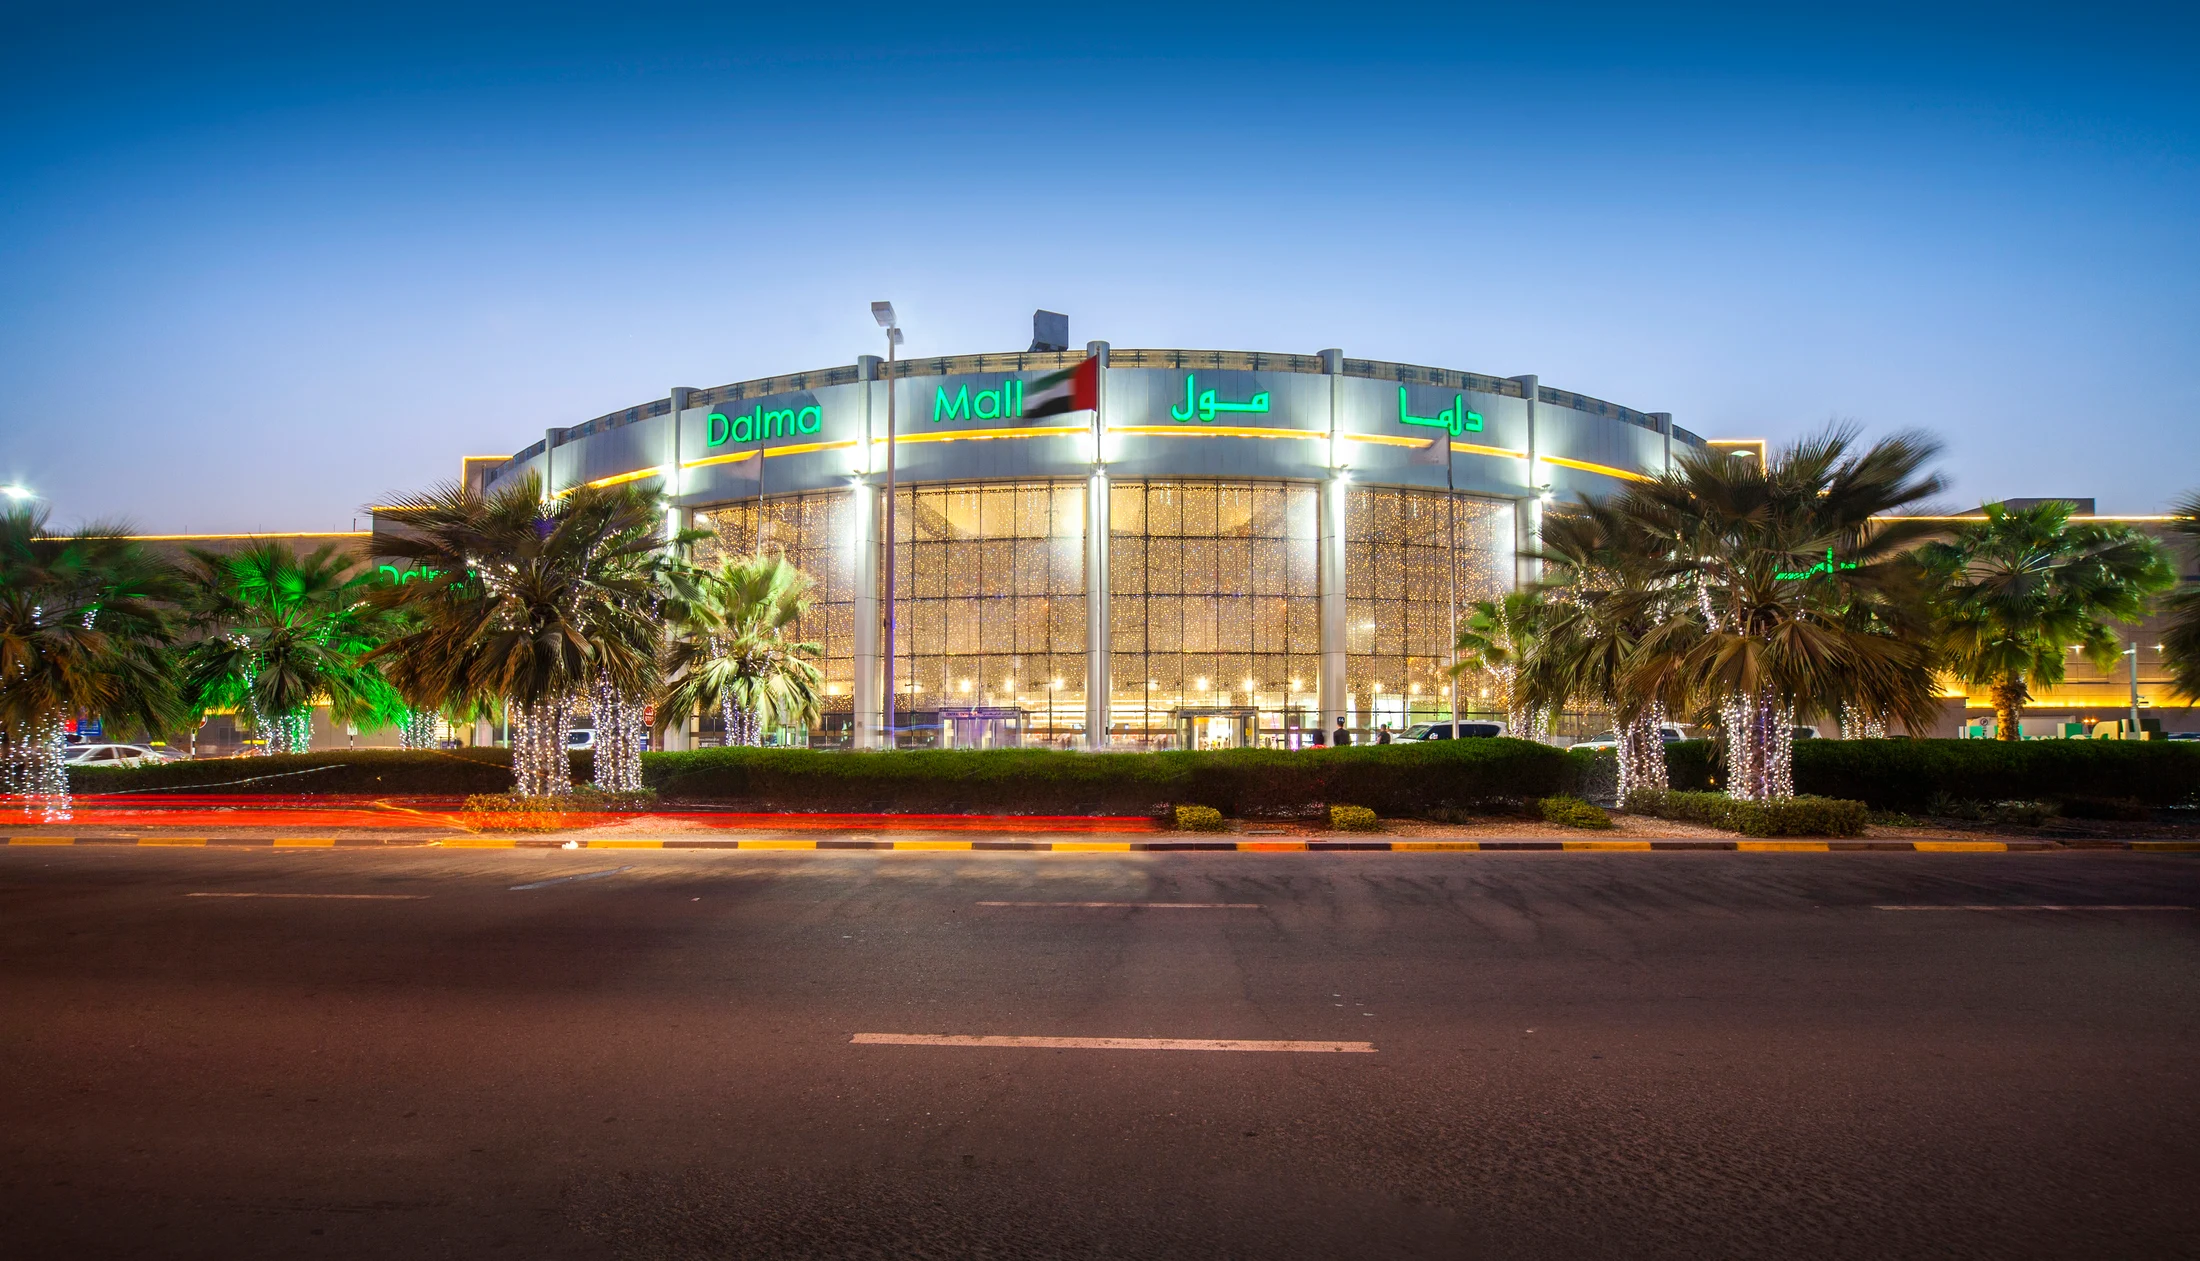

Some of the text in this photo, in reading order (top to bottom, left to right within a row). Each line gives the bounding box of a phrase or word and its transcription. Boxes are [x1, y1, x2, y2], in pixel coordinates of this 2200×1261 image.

[707, 379, 1023, 447] Dalma Mall
[1171, 373, 1484, 437] دلما مول
